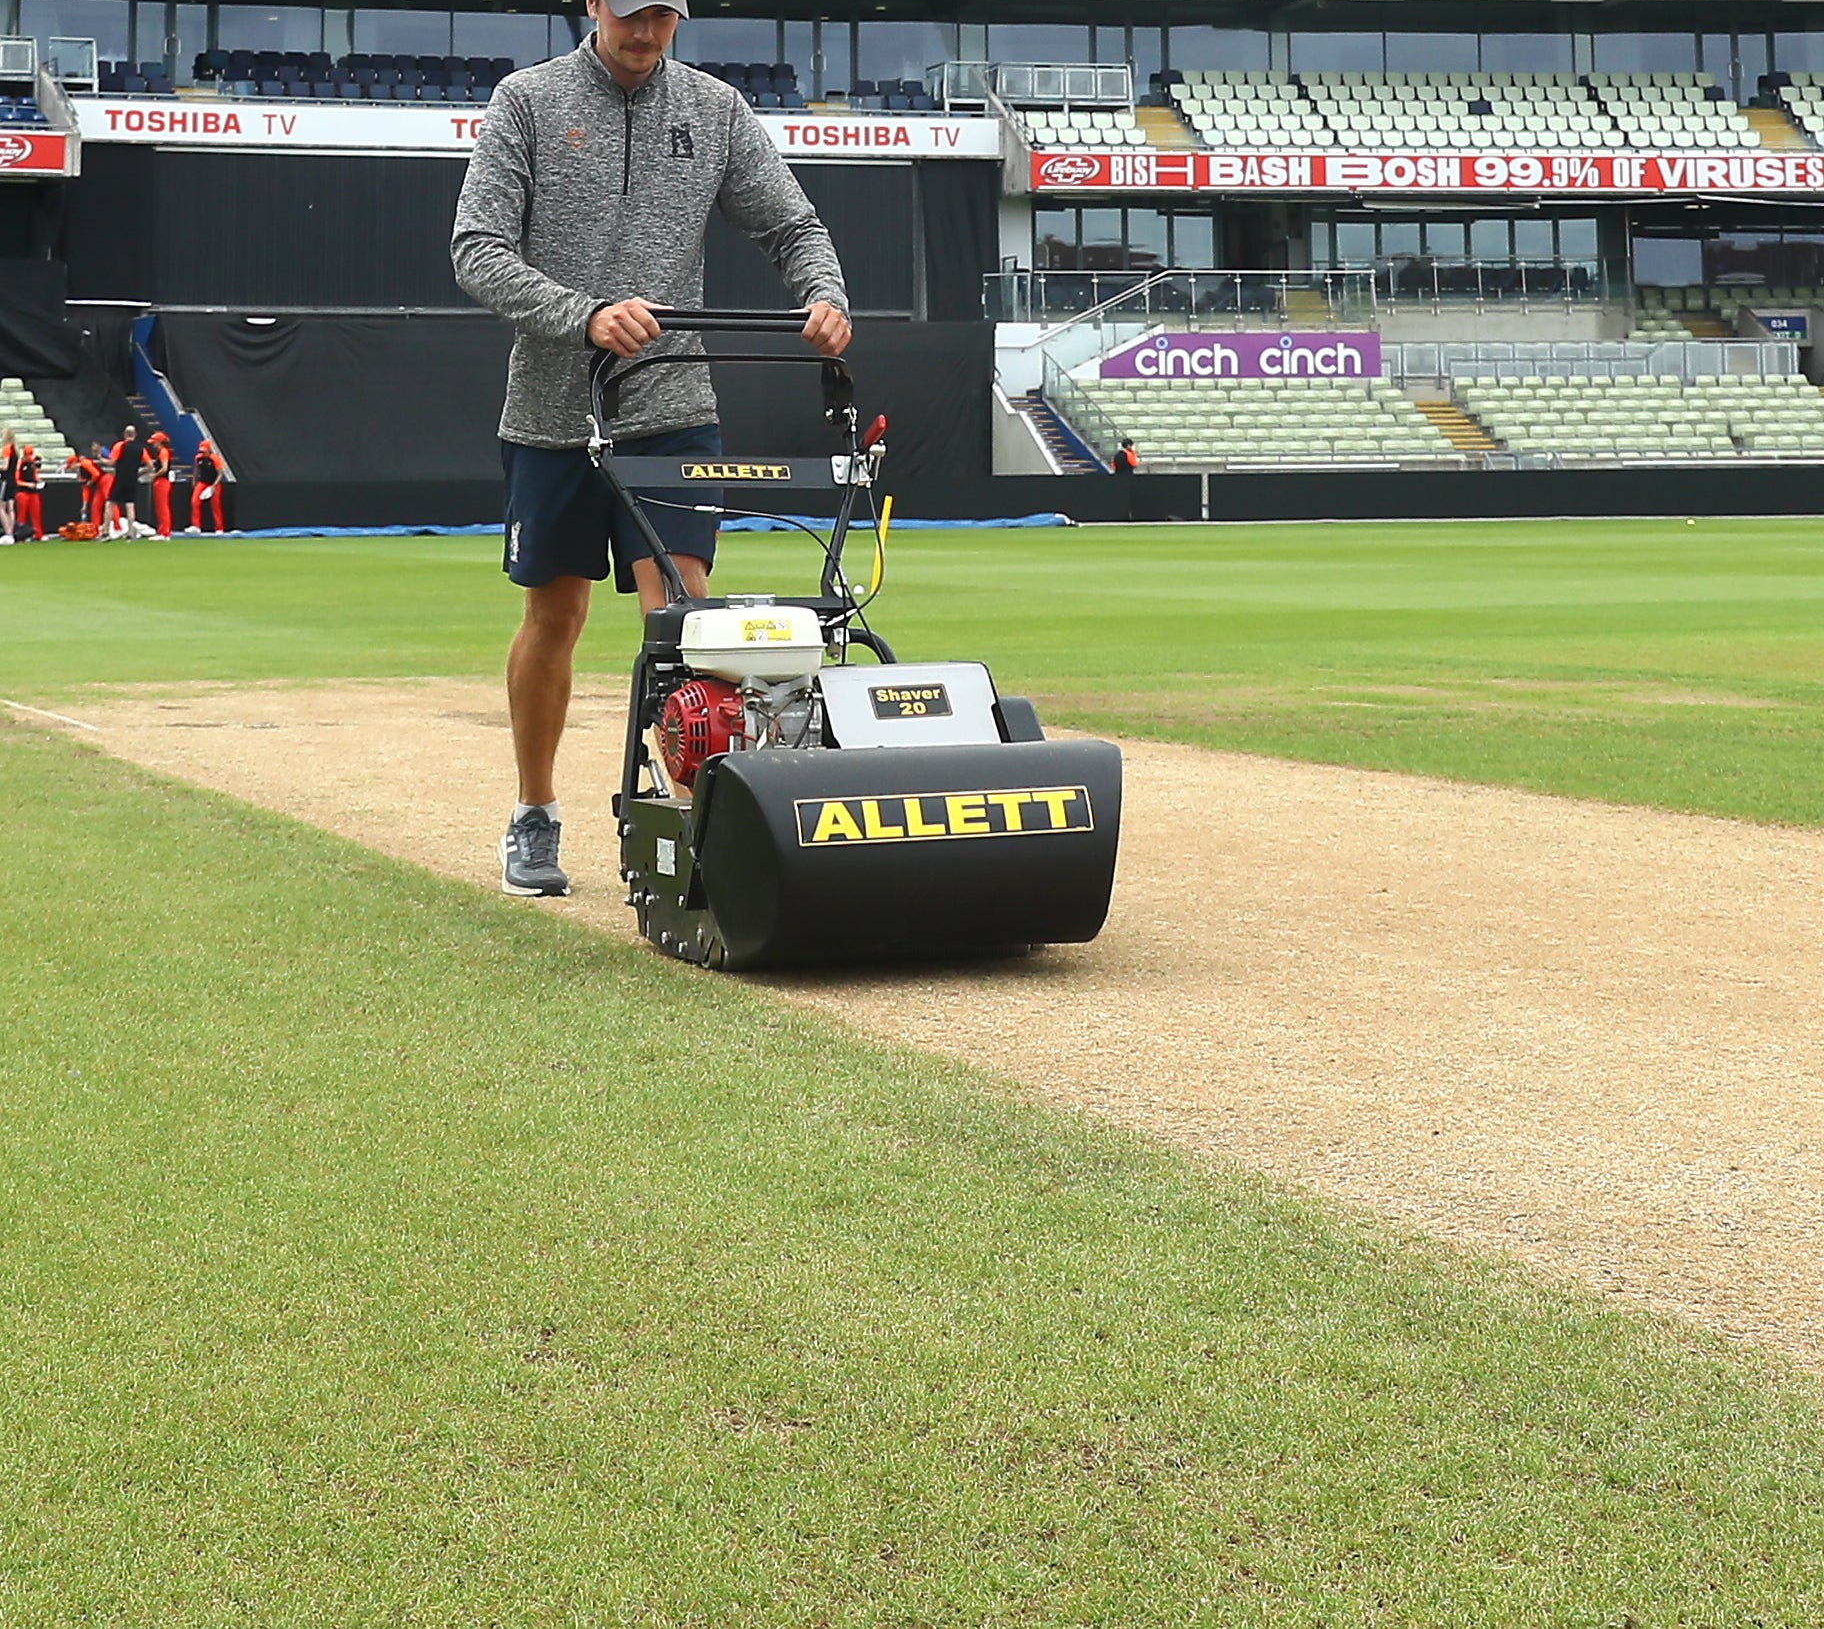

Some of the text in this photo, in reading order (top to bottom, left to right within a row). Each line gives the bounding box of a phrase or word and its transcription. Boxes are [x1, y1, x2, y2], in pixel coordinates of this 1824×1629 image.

[105, 110, 296, 135] TOSHIBA TV
[783, 126, 960, 148] TOSHIBA TV
[1110, 156, 1824, 187] BISH BASH BOSH 99.9% OF VIRUSES
[1135, 337, 1238, 375] cinch
[1259, 336, 1361, 375] cinch
[690, 464, 783, 478] ALLETT
[876, 689, 940, 702] Shaver
[899, 702, 927, 715] 20
[812, 790, 1077, 842] ALLETT
